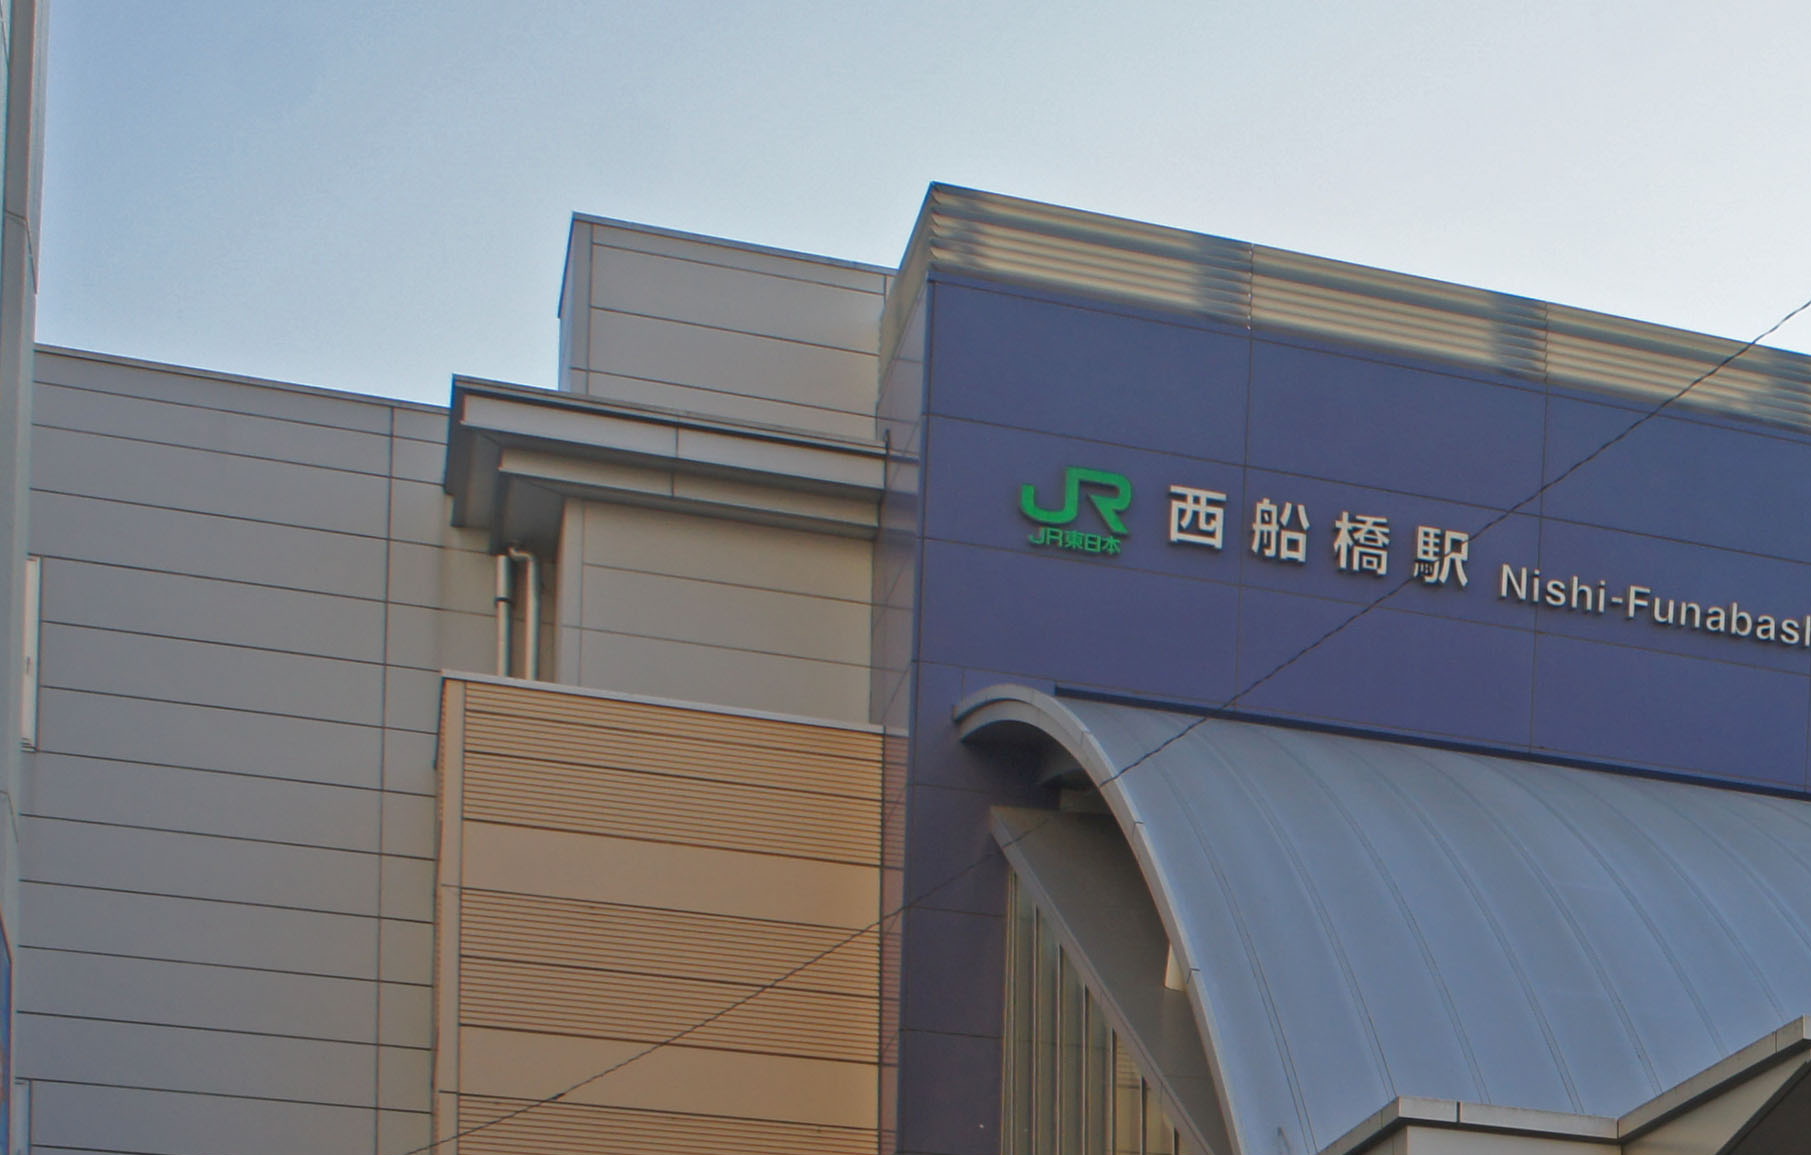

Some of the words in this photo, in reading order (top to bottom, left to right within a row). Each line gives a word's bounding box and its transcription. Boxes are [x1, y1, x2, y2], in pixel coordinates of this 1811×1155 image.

[1021, 466, 1133, 535] JR
[1028, 527, 1121, 555] JR東日本
[1168, 484, 1470, 587] 西船橋駅
